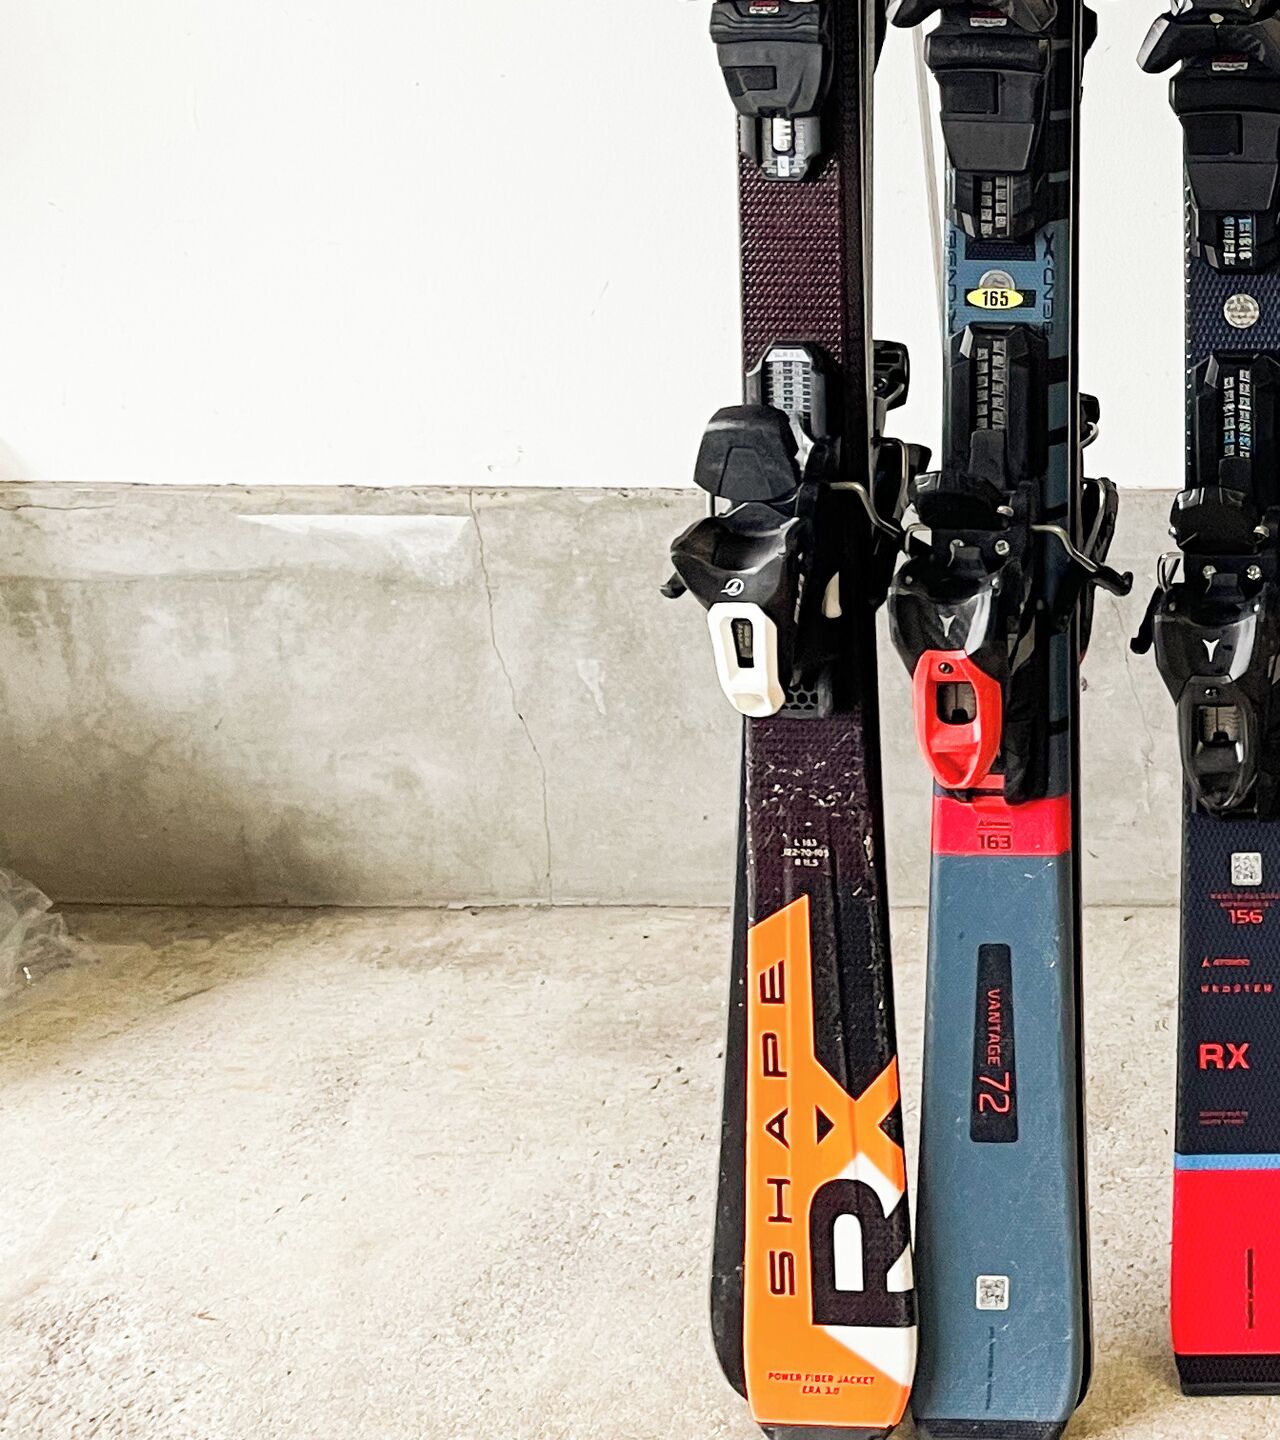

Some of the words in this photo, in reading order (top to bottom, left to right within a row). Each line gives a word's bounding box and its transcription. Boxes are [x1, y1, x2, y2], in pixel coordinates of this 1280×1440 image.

[982, 290, 1010, 307] 165
[978, 834, 1012, 850] 163
[1228, 909, 1264, 925] 156
[986, 988, 1001, 1066] VANTAGE
[1198, 1042, 1250, 1071] RX
[979, 1070, 1012, 1115] 72
[759, 958, 796, 1297] SHAPE
[768, 1371, 802, 1383] POWER
[803, 1372, 834, 1385] FIBER
[837, 1374, 876, 1386] JACKET
